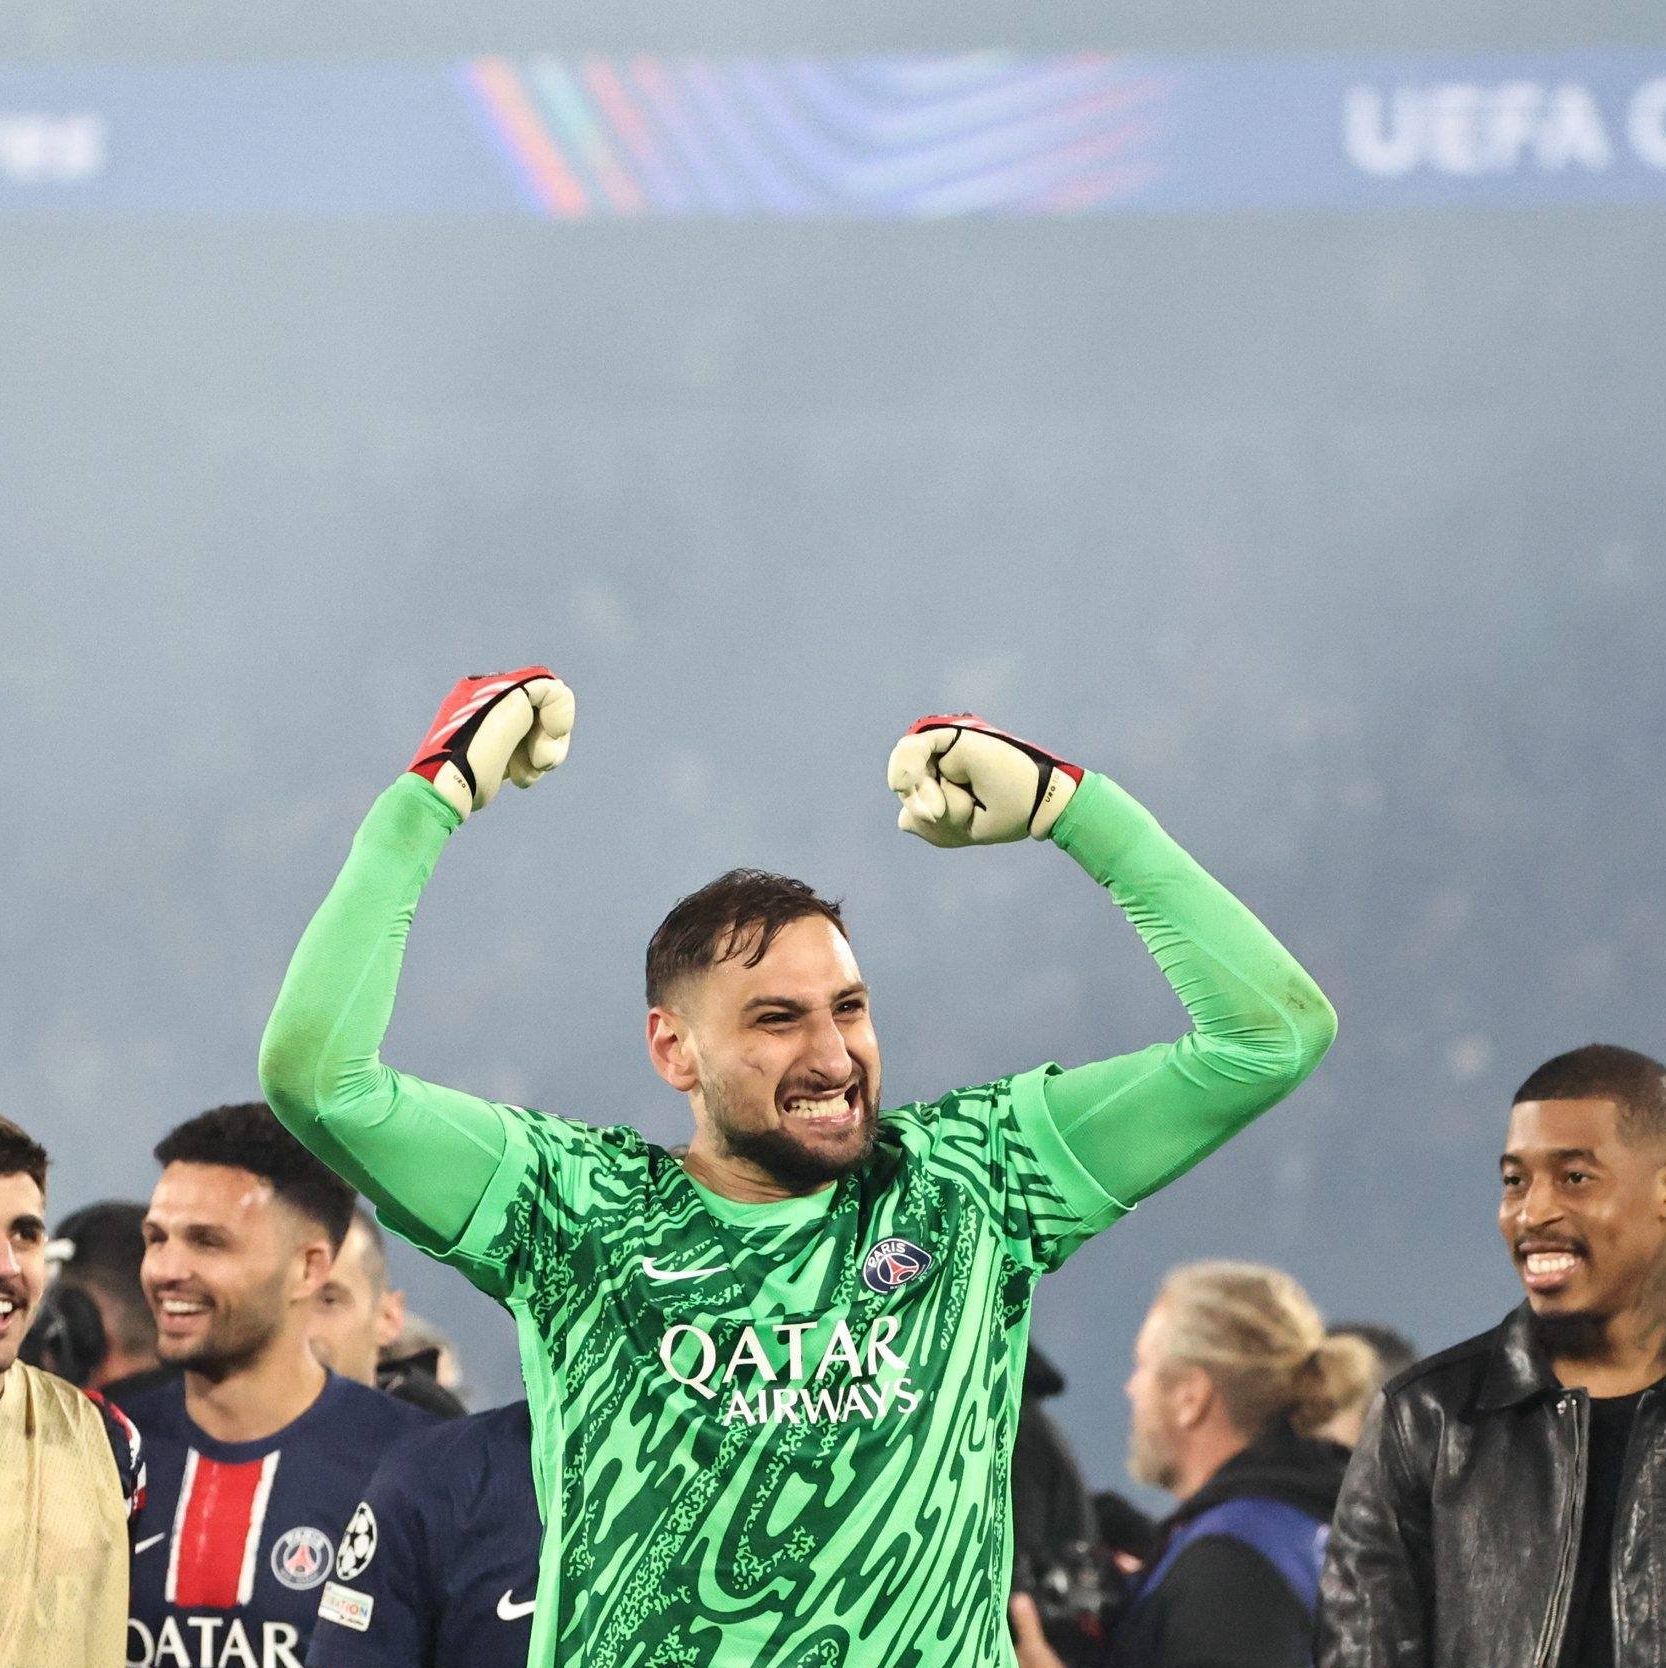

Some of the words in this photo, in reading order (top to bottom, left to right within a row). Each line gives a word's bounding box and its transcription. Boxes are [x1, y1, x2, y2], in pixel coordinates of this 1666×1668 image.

[1345, 84, 1609, 174] UEFA
[868, 1242, 906, 1268] PARIS
[659, 1316, 910, 1400] QATAR
[723, 1378, 919, 1427] AIRWAYS
